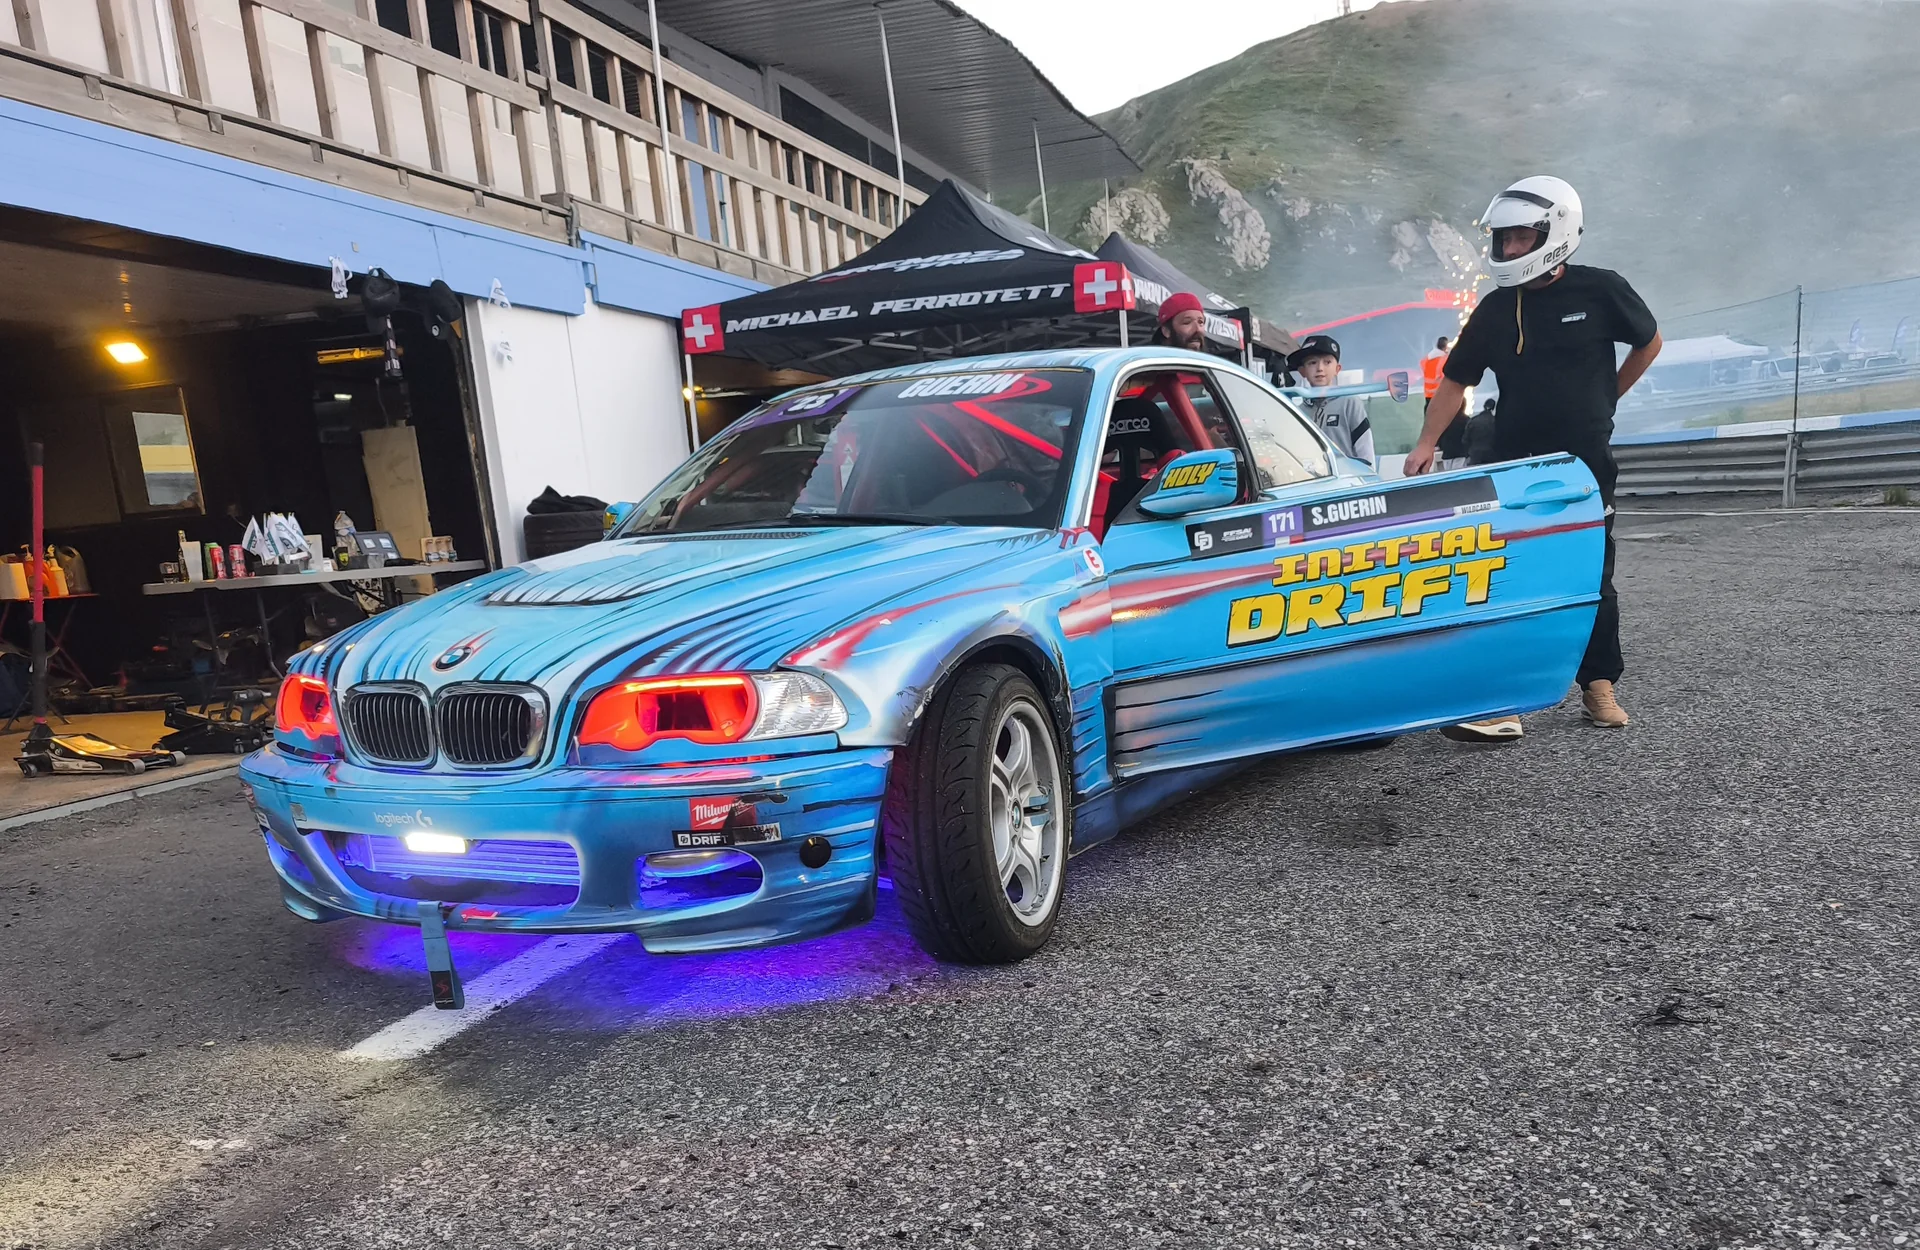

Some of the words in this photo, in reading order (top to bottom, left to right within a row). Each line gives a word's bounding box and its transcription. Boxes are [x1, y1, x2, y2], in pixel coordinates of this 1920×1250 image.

[725, 305, 859, 333] MICHAEL
[869, 283, 1071, 315] PERROTETT
[897, 373, 1027, 399] GUERIN
[1162, 461, 1219, 489] HOLY
[1268, 511, 1295, 533] 171
[1311, 495, 1388, 526] S.GUERIN
[1461, 503, 1492, 515] WILDCARD
[1272, 522, 1507, 586] INITIAL
[1226, 556, 1507, 648] DRIFT
[373, 811, 415, 828] logitech
